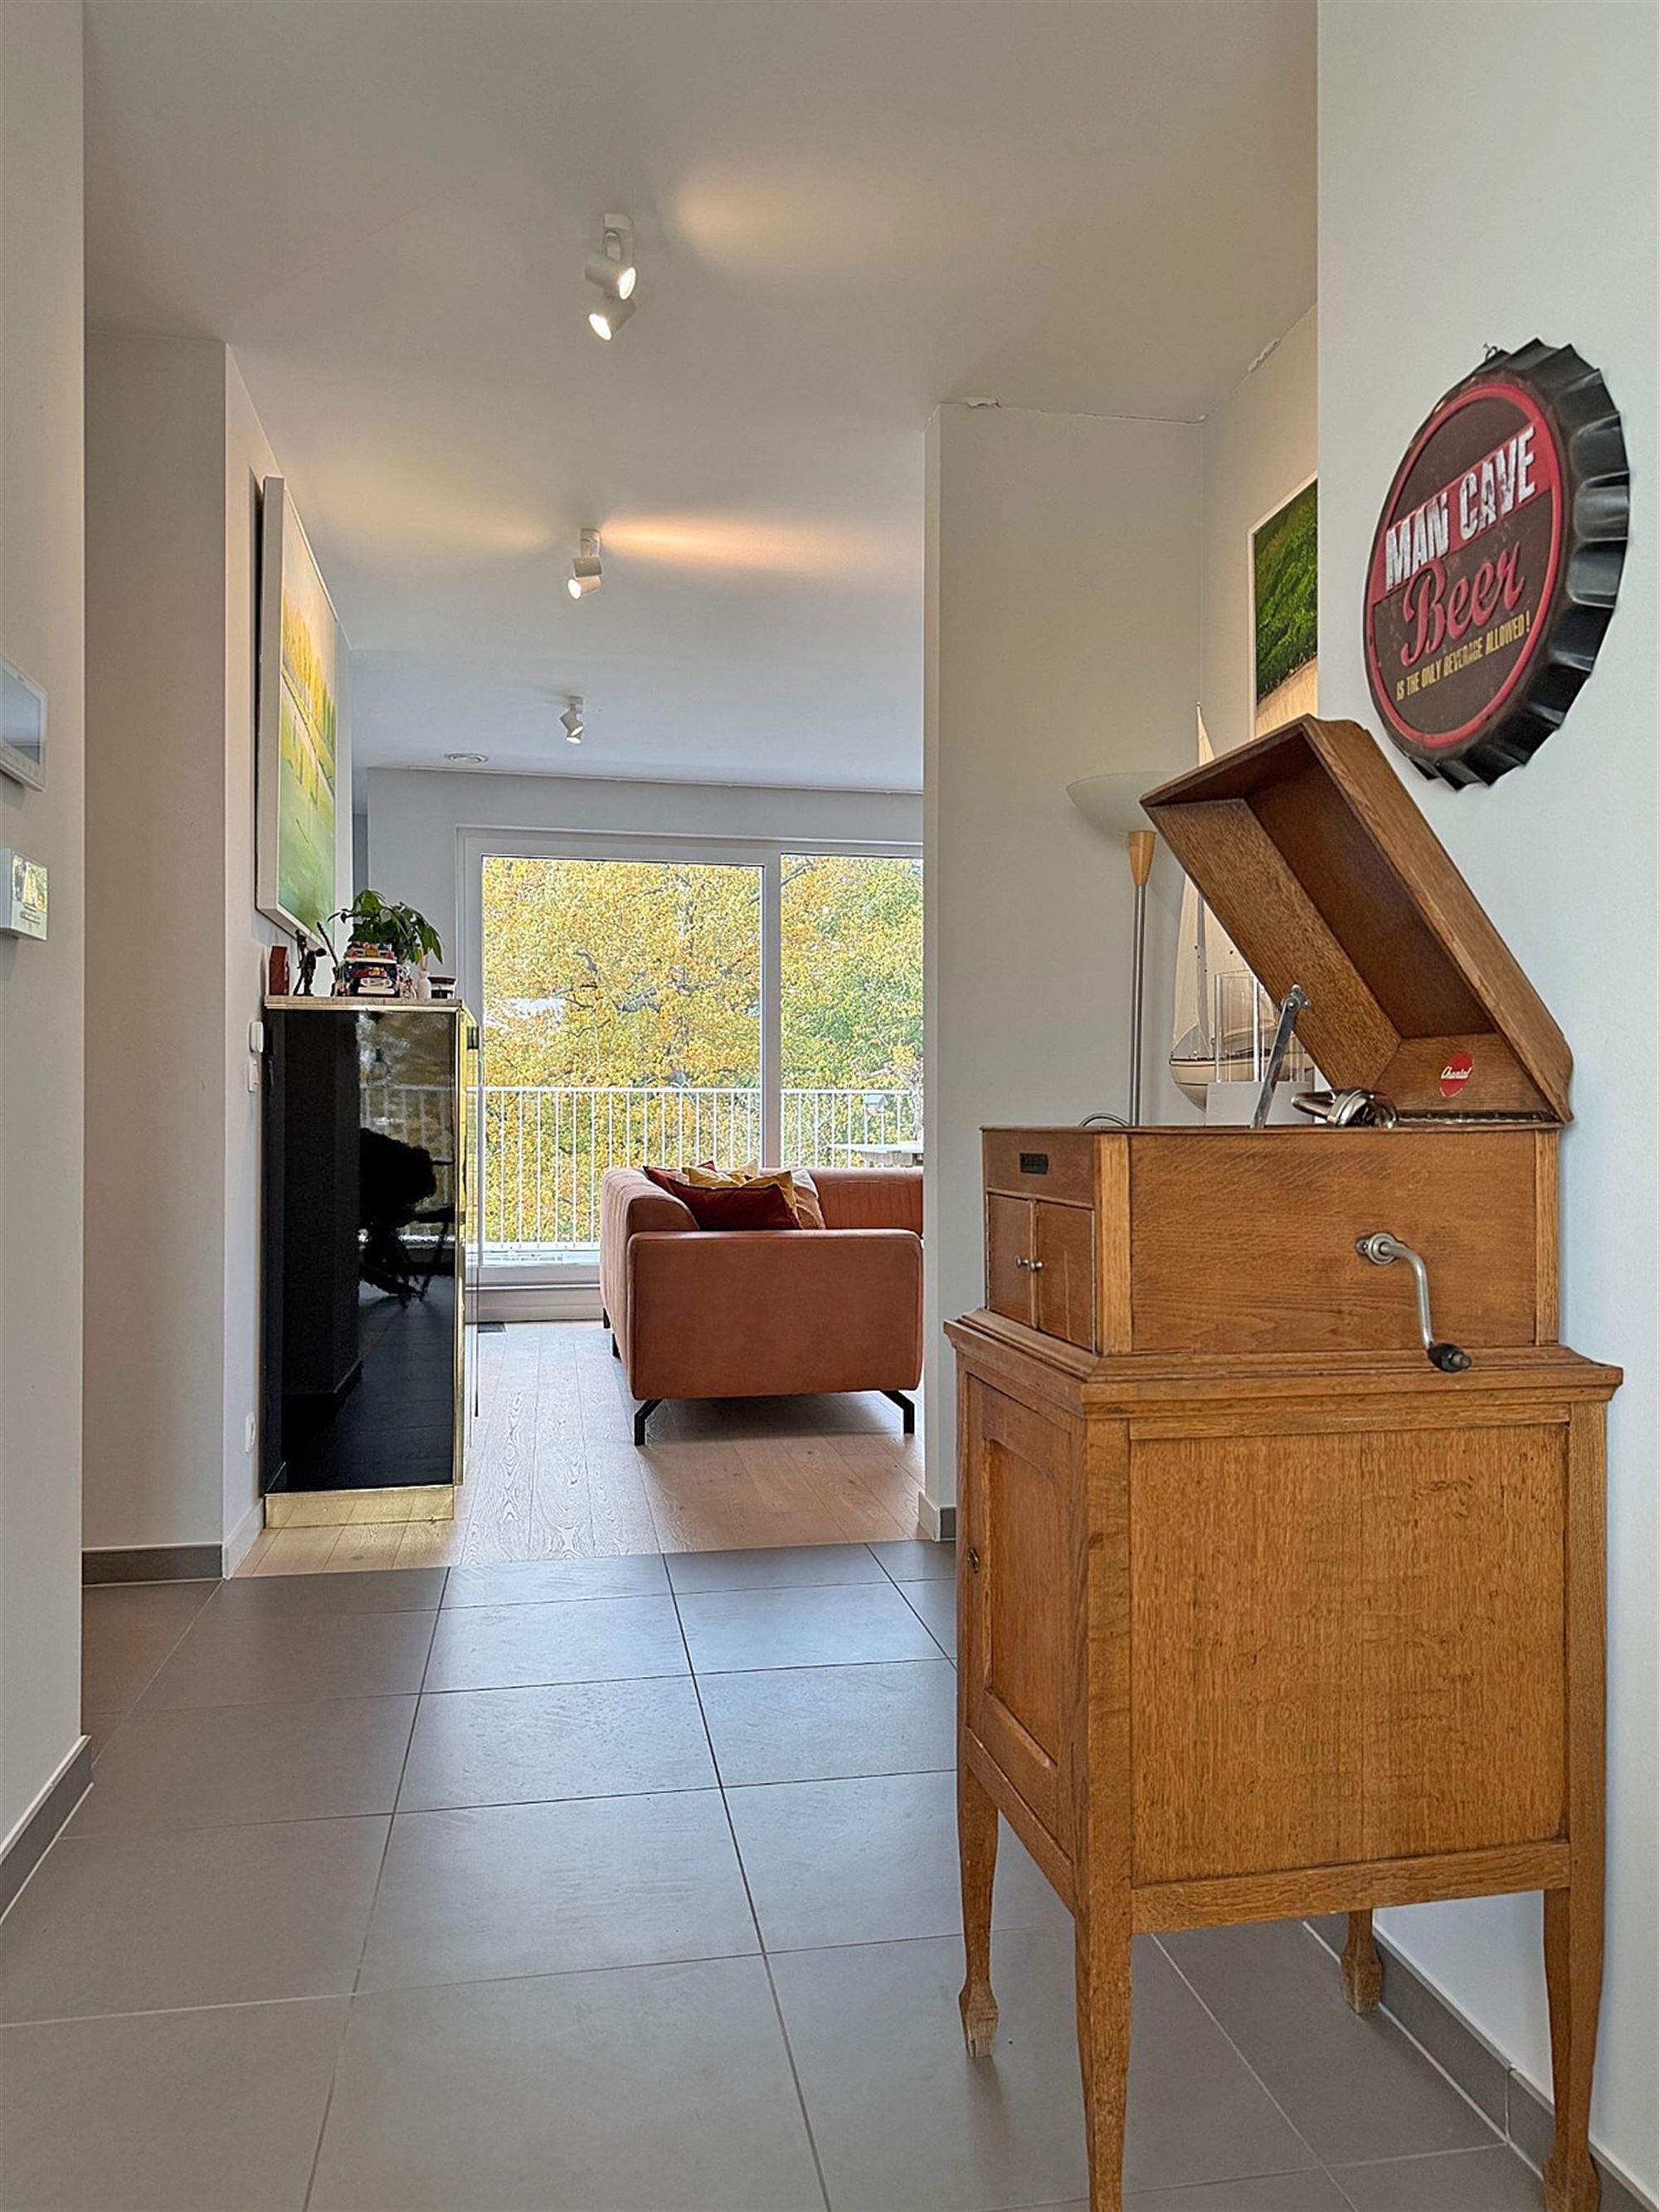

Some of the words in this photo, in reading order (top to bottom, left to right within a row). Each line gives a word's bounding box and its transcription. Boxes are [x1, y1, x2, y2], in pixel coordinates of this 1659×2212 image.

[1385, 491, 1449, 592] MAN
[1459, 425, 1535, 542] CAVE
[1400, 541, 1525, 667] Beer
[1396, 679, 1405, 702] IS
[1406, 671, 1420, 697] THE
[1421, 659, 1443, 688] ONLY
[1443, 636, 1483, 678] BEVERAGE
